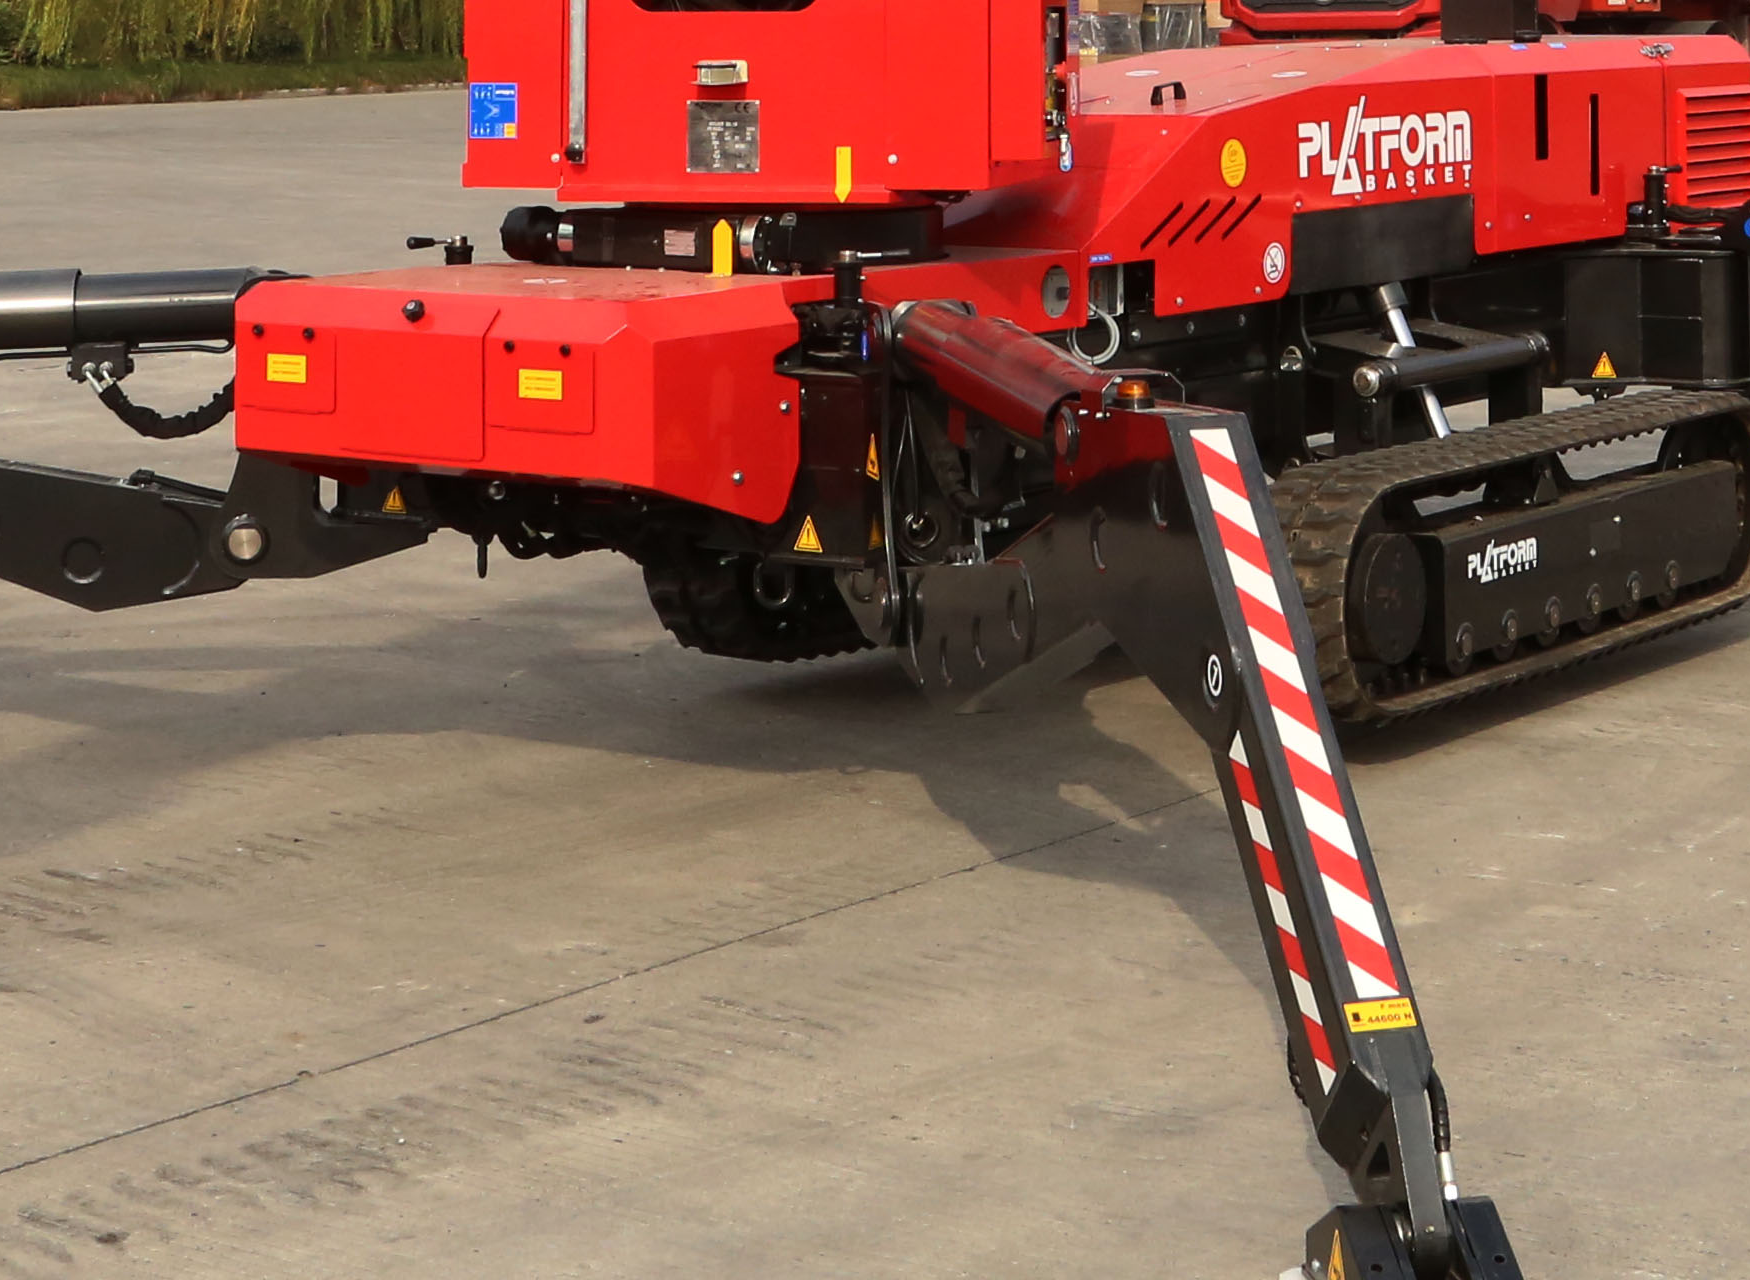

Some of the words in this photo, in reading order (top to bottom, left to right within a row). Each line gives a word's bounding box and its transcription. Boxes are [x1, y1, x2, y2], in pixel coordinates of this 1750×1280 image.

[1298, 95, 1472, 196] PLATFORM
[1365, 164, 1472, 192] BASKET
[1467, 537, 1537, 583] PLATFORM
